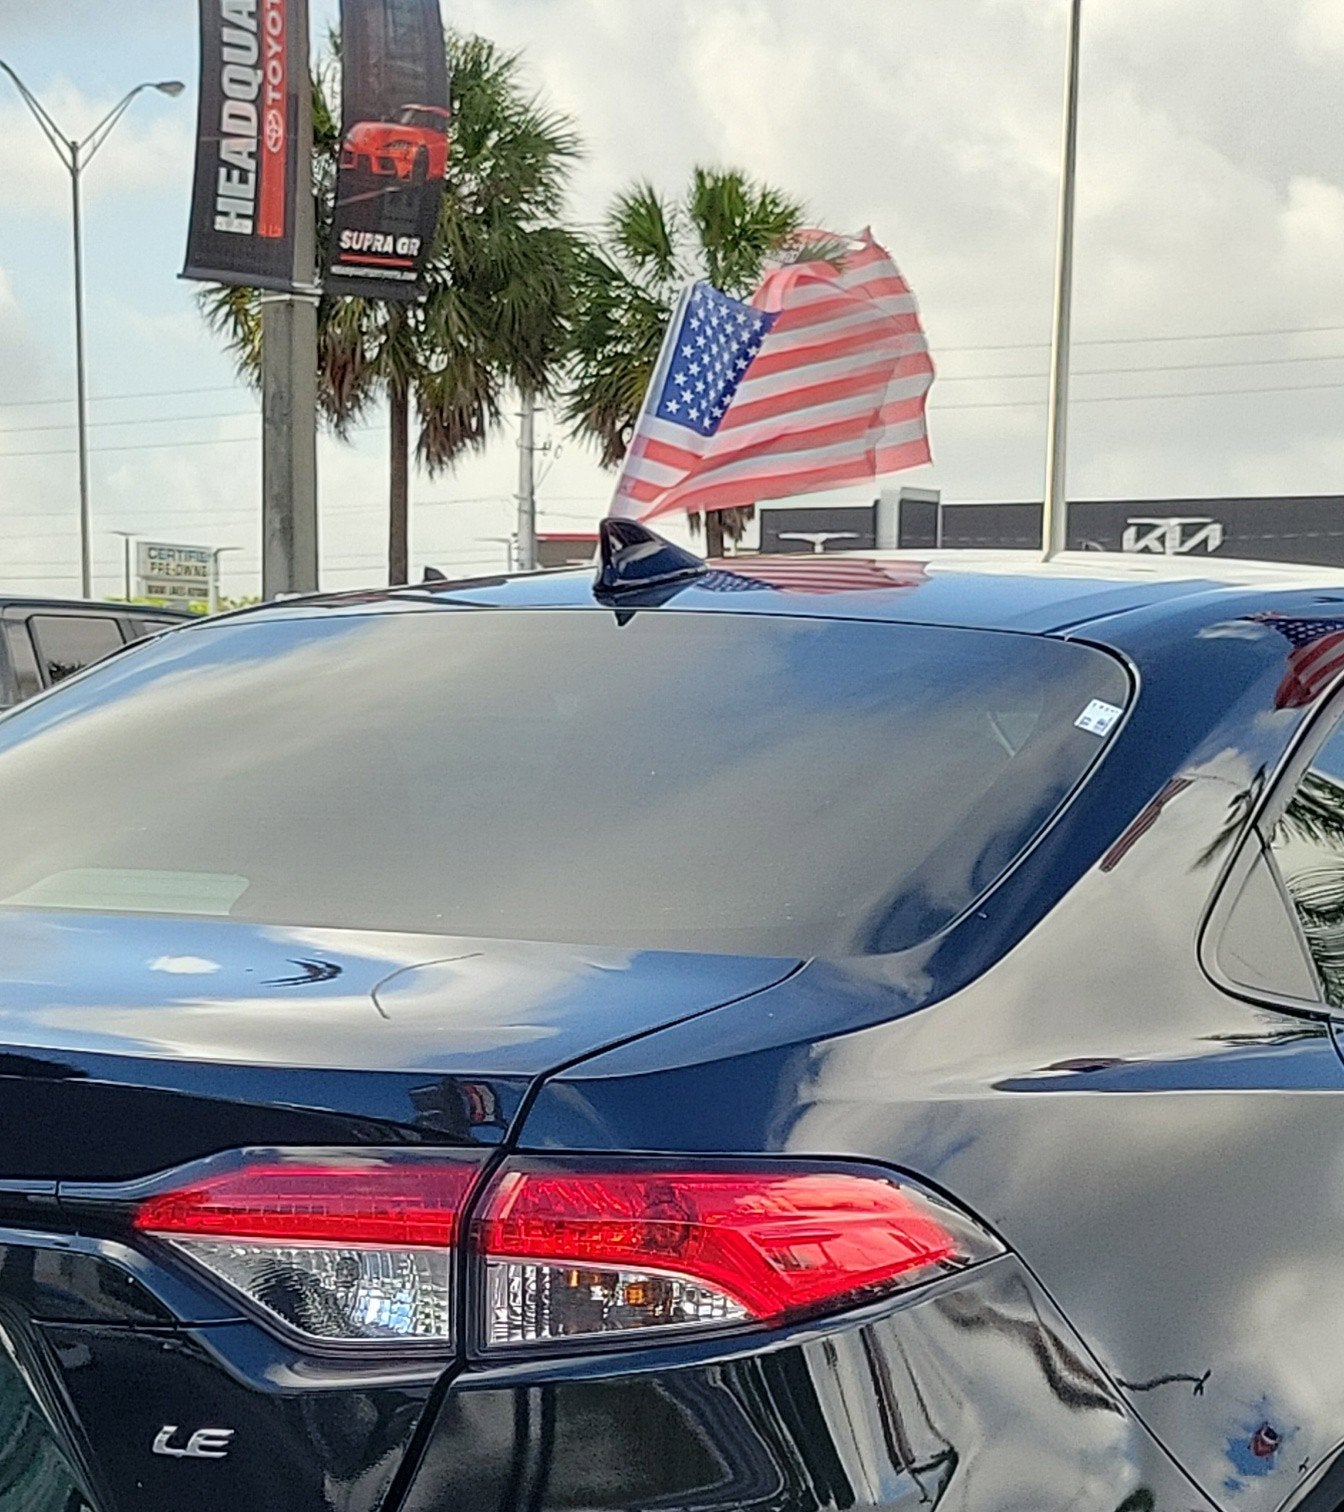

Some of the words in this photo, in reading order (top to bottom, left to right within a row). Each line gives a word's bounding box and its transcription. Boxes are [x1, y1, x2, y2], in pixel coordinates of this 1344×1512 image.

[340, 229, 394, 254] SUPRA
[396, 237, 420, 257] GR
[152, 1425, 235, 1458] LE
